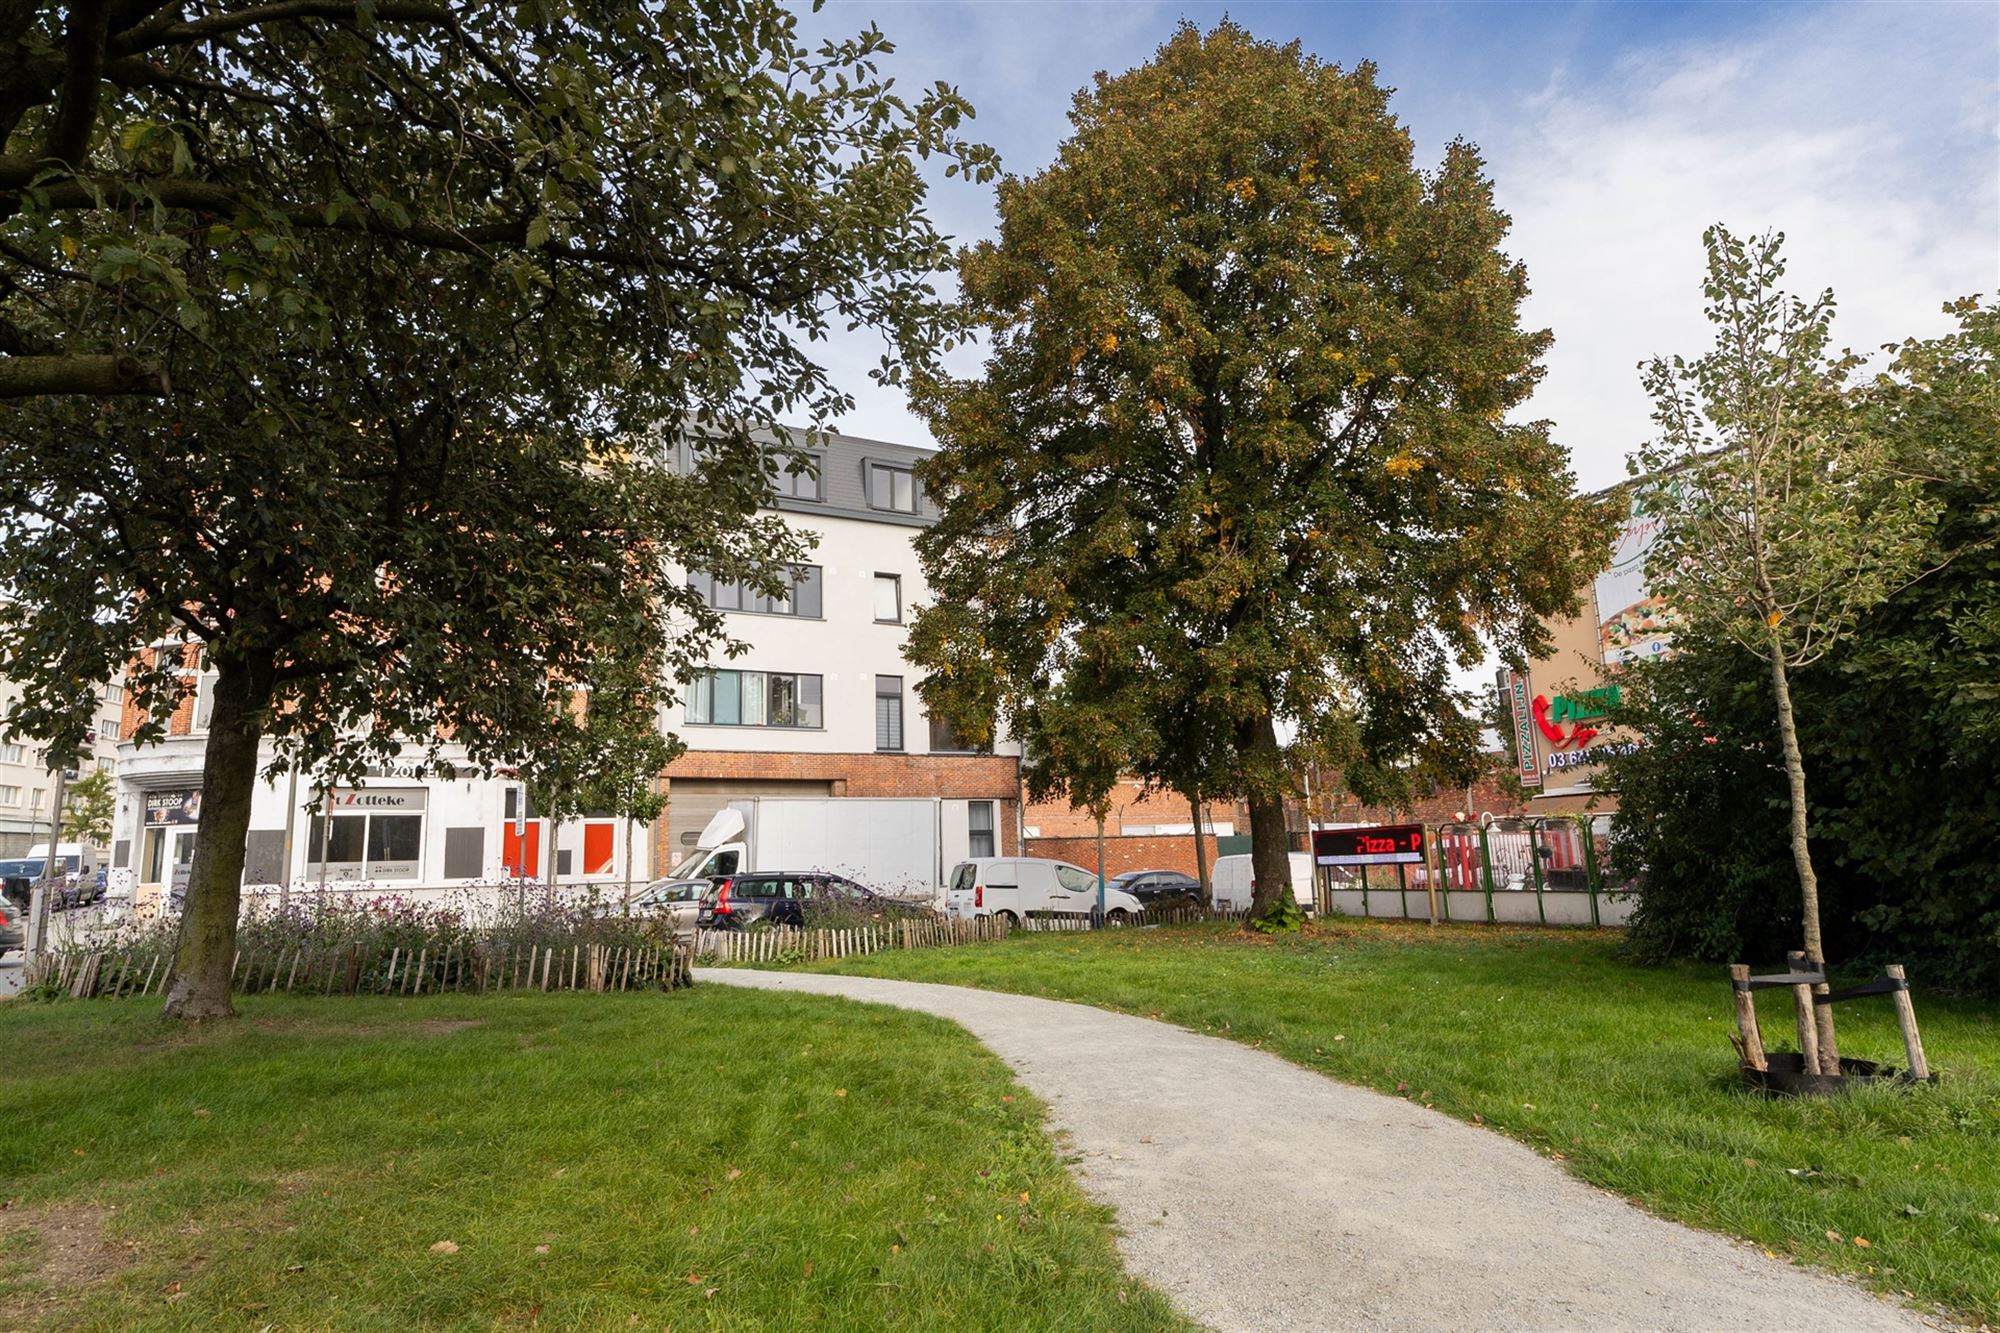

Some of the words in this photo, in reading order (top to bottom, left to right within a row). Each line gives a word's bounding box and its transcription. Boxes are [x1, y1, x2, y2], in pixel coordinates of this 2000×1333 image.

[1549, 753, 1565, 767] 03
[162, 797, 183, 807] STOOP
[345, 793, 405, 806] Zotteke
[1356, 835, 1395, 853] Pizza
[1411, 833, 1421, 850] P
